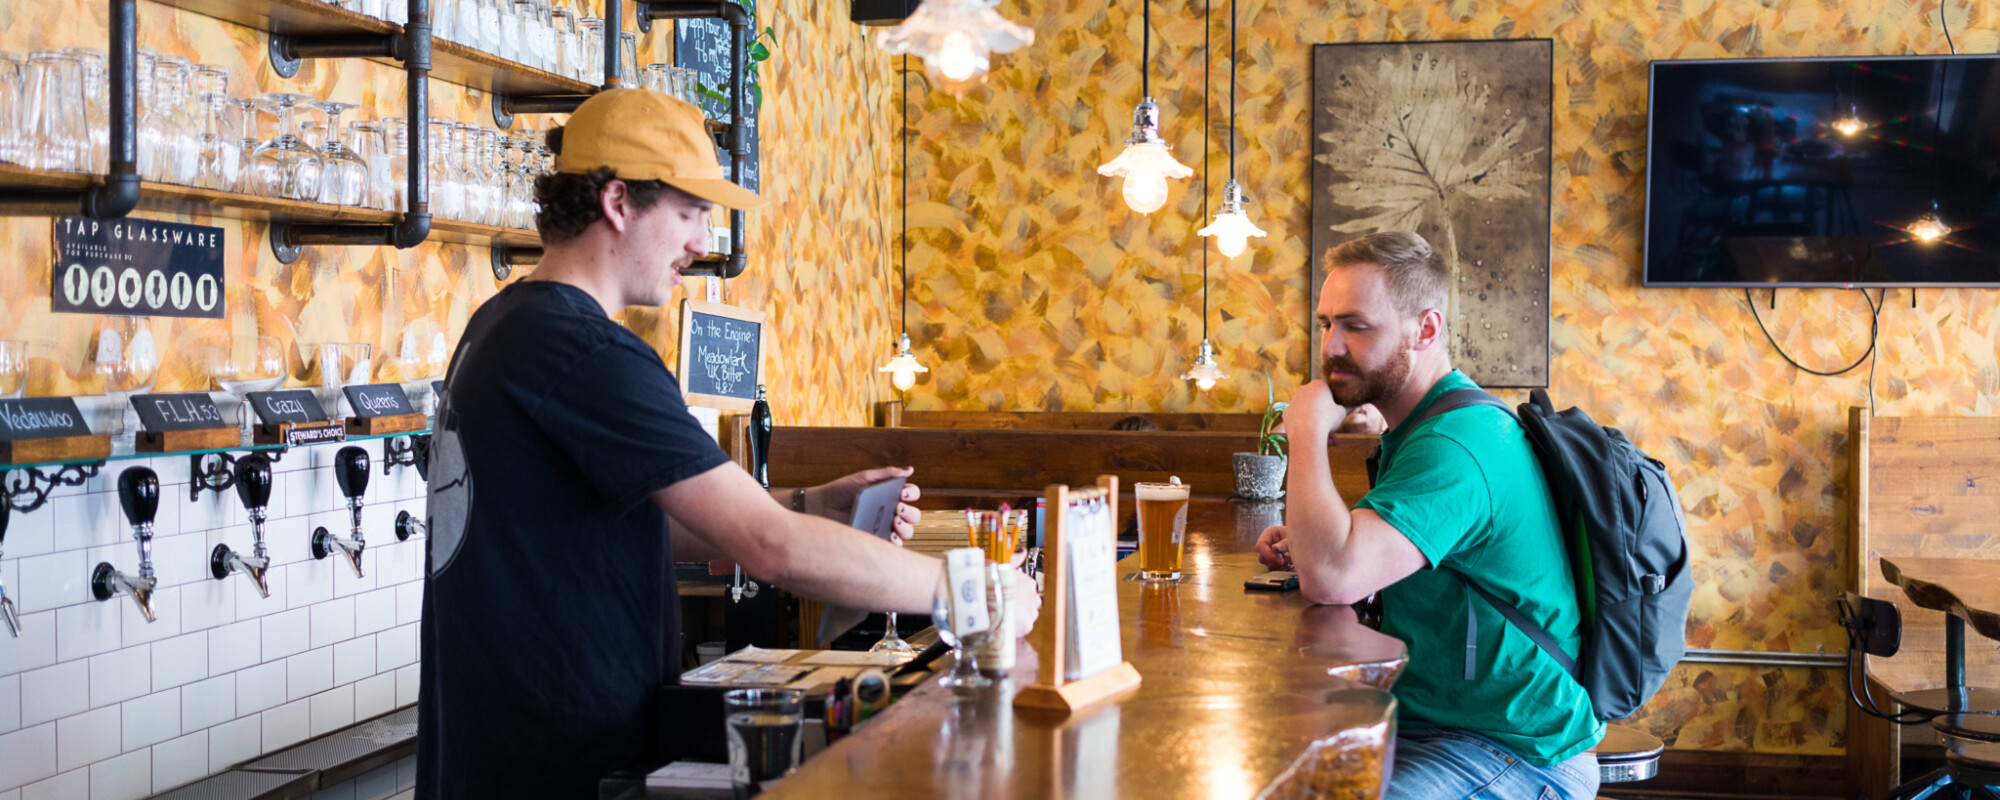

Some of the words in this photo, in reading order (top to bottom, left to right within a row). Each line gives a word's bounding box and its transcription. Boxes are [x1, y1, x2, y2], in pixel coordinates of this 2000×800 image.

[65, 218, 99, 237] TAP
[114, 224, 217, 248] GLASSWARE
[65, 249, 80, 257] FOR
[85, 251, 122, 261] PURCHASE
[66, 242, 108, 252] AVAILABLE
[691, 318, 703, 337] On
[707, 319, 721, 338] the
[725, 321, 755, 353] Engine:
[266, 396, 310, 423] Crazy
[289, 429, 323, 442] STEWARD'S
[323, 427, 345, 438] CHOICE
